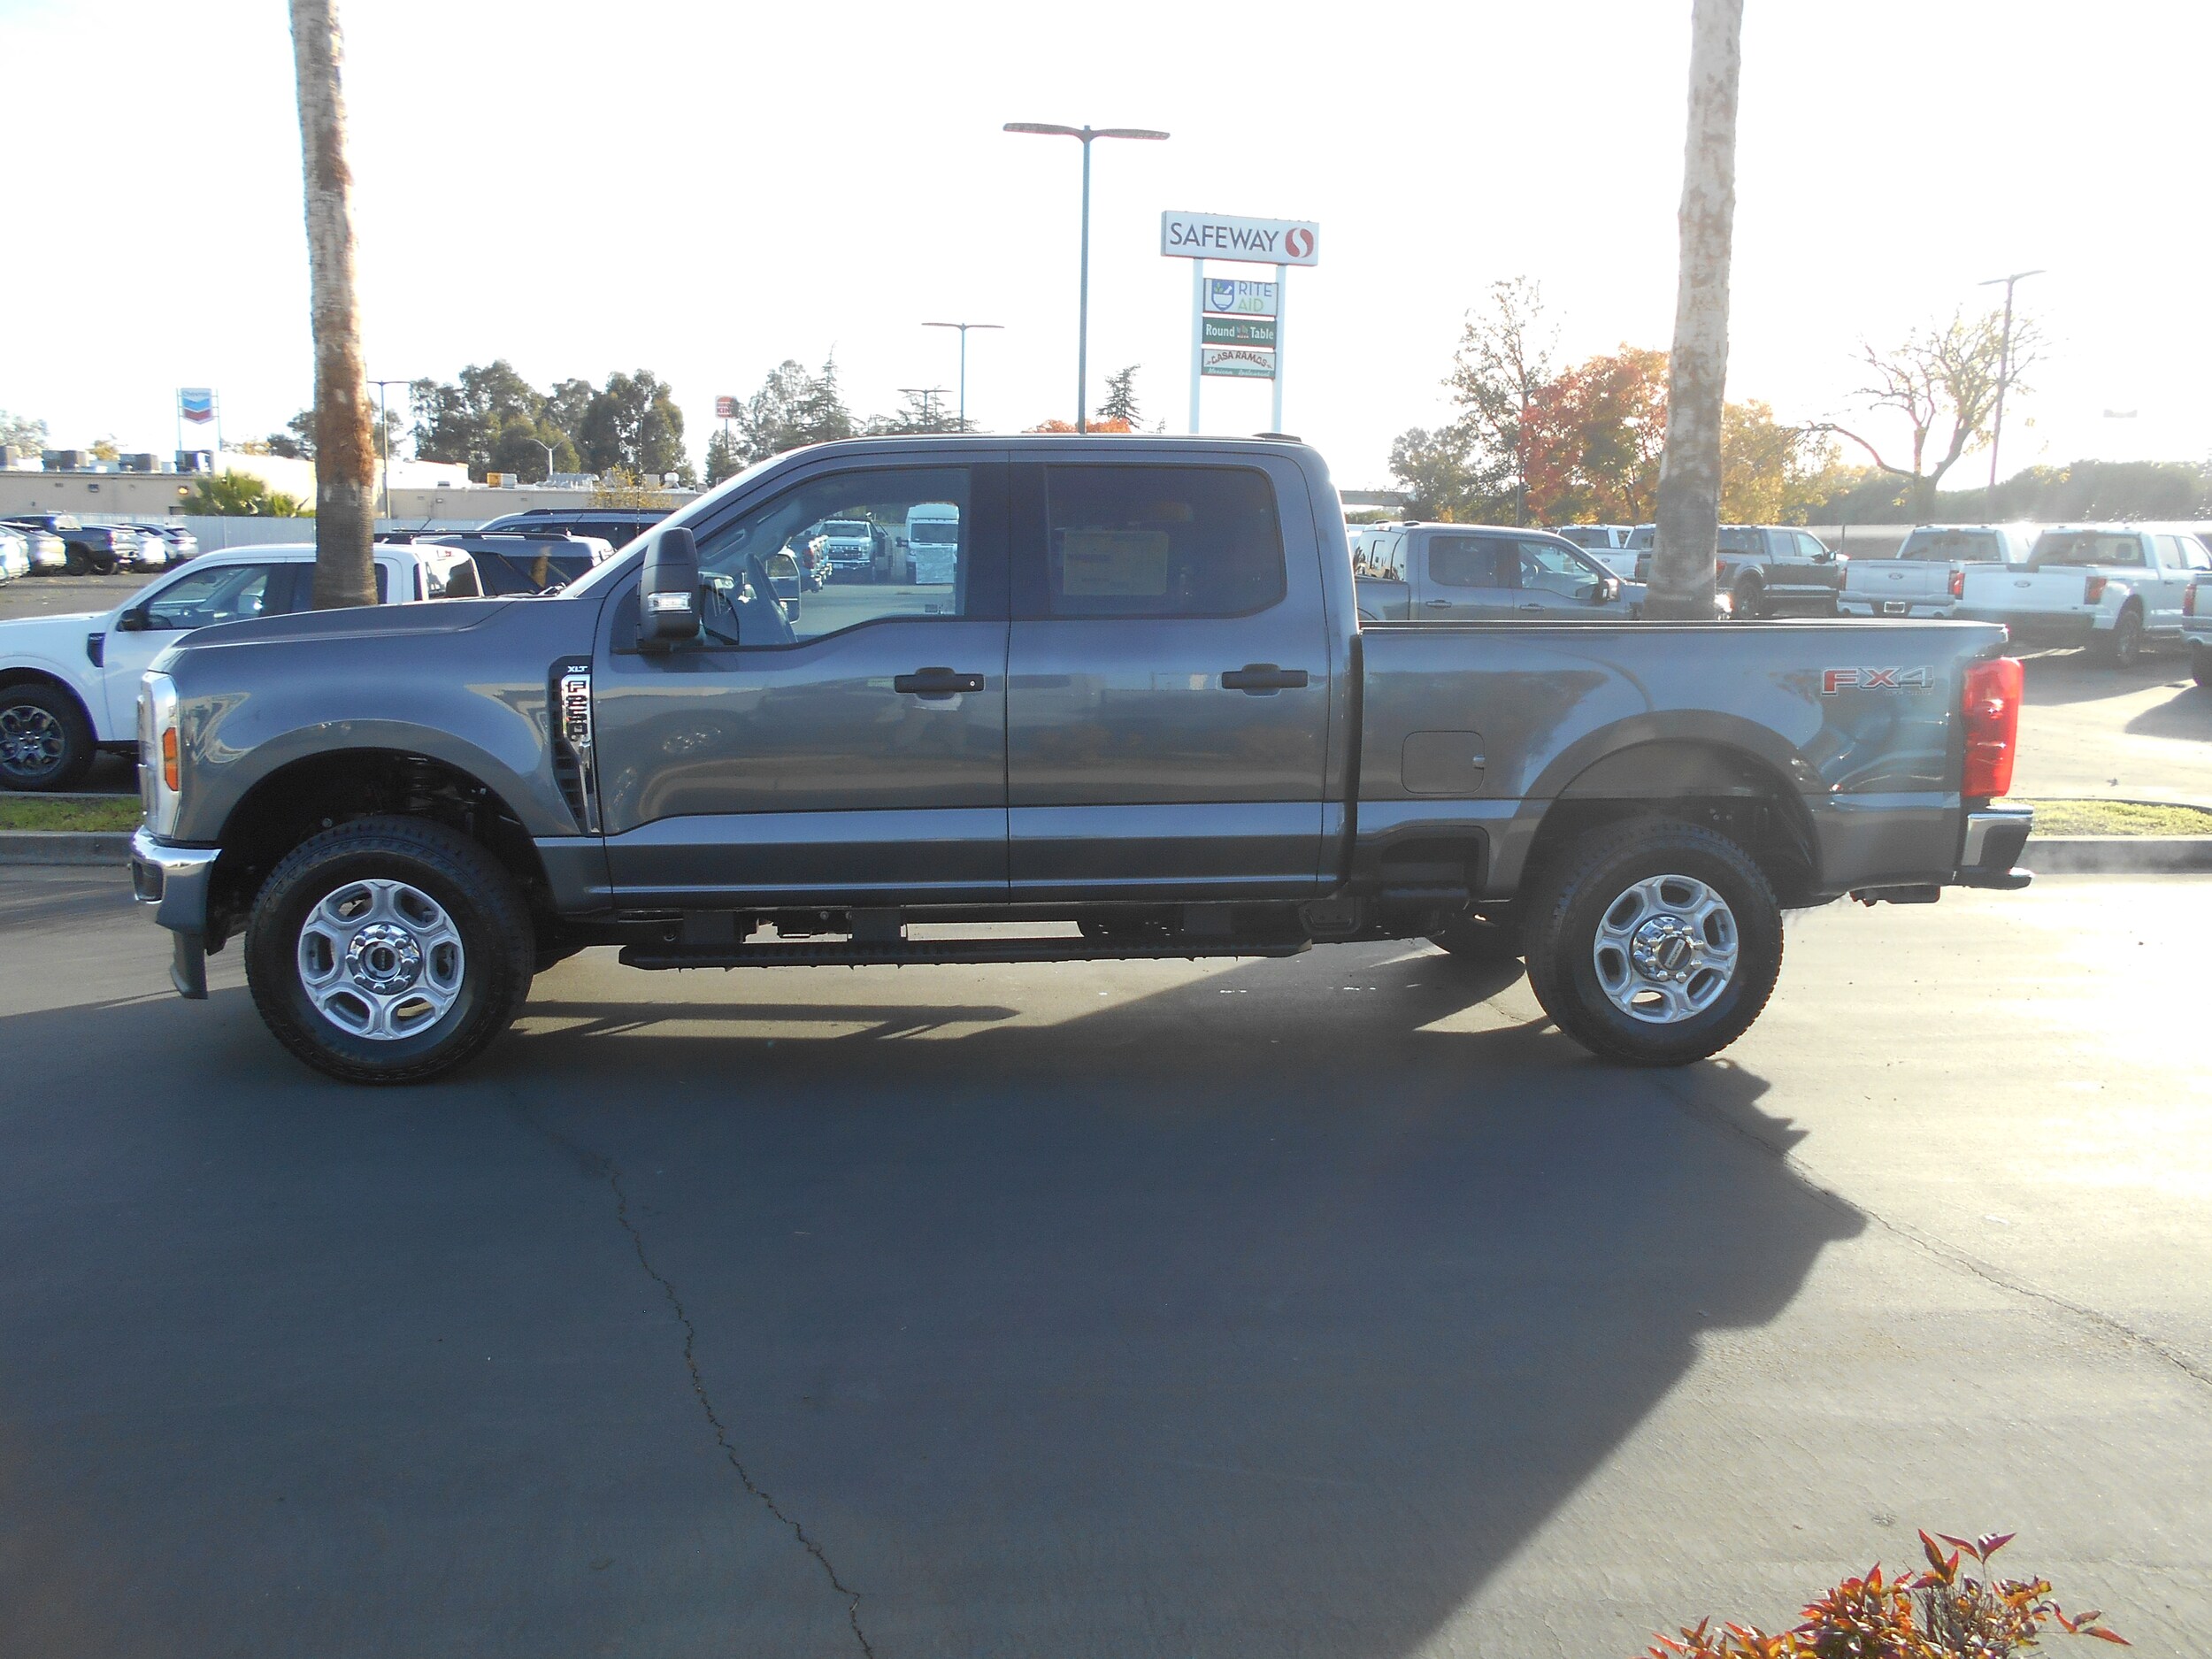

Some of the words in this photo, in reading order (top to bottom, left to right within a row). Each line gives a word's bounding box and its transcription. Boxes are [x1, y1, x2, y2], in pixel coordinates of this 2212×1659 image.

[1169, 222, 1279, 252] SAFEWAY
[1239, 281, 1272, 297] RITE
[1205, 323, 1235, 337] Round
[1250, 326, 1274, 340] Table
[1211, 350, 1233, 365] CASA
[1235, 350, 1268, 367] RAMOS
[1822, 665, 1934, 696] FX4
